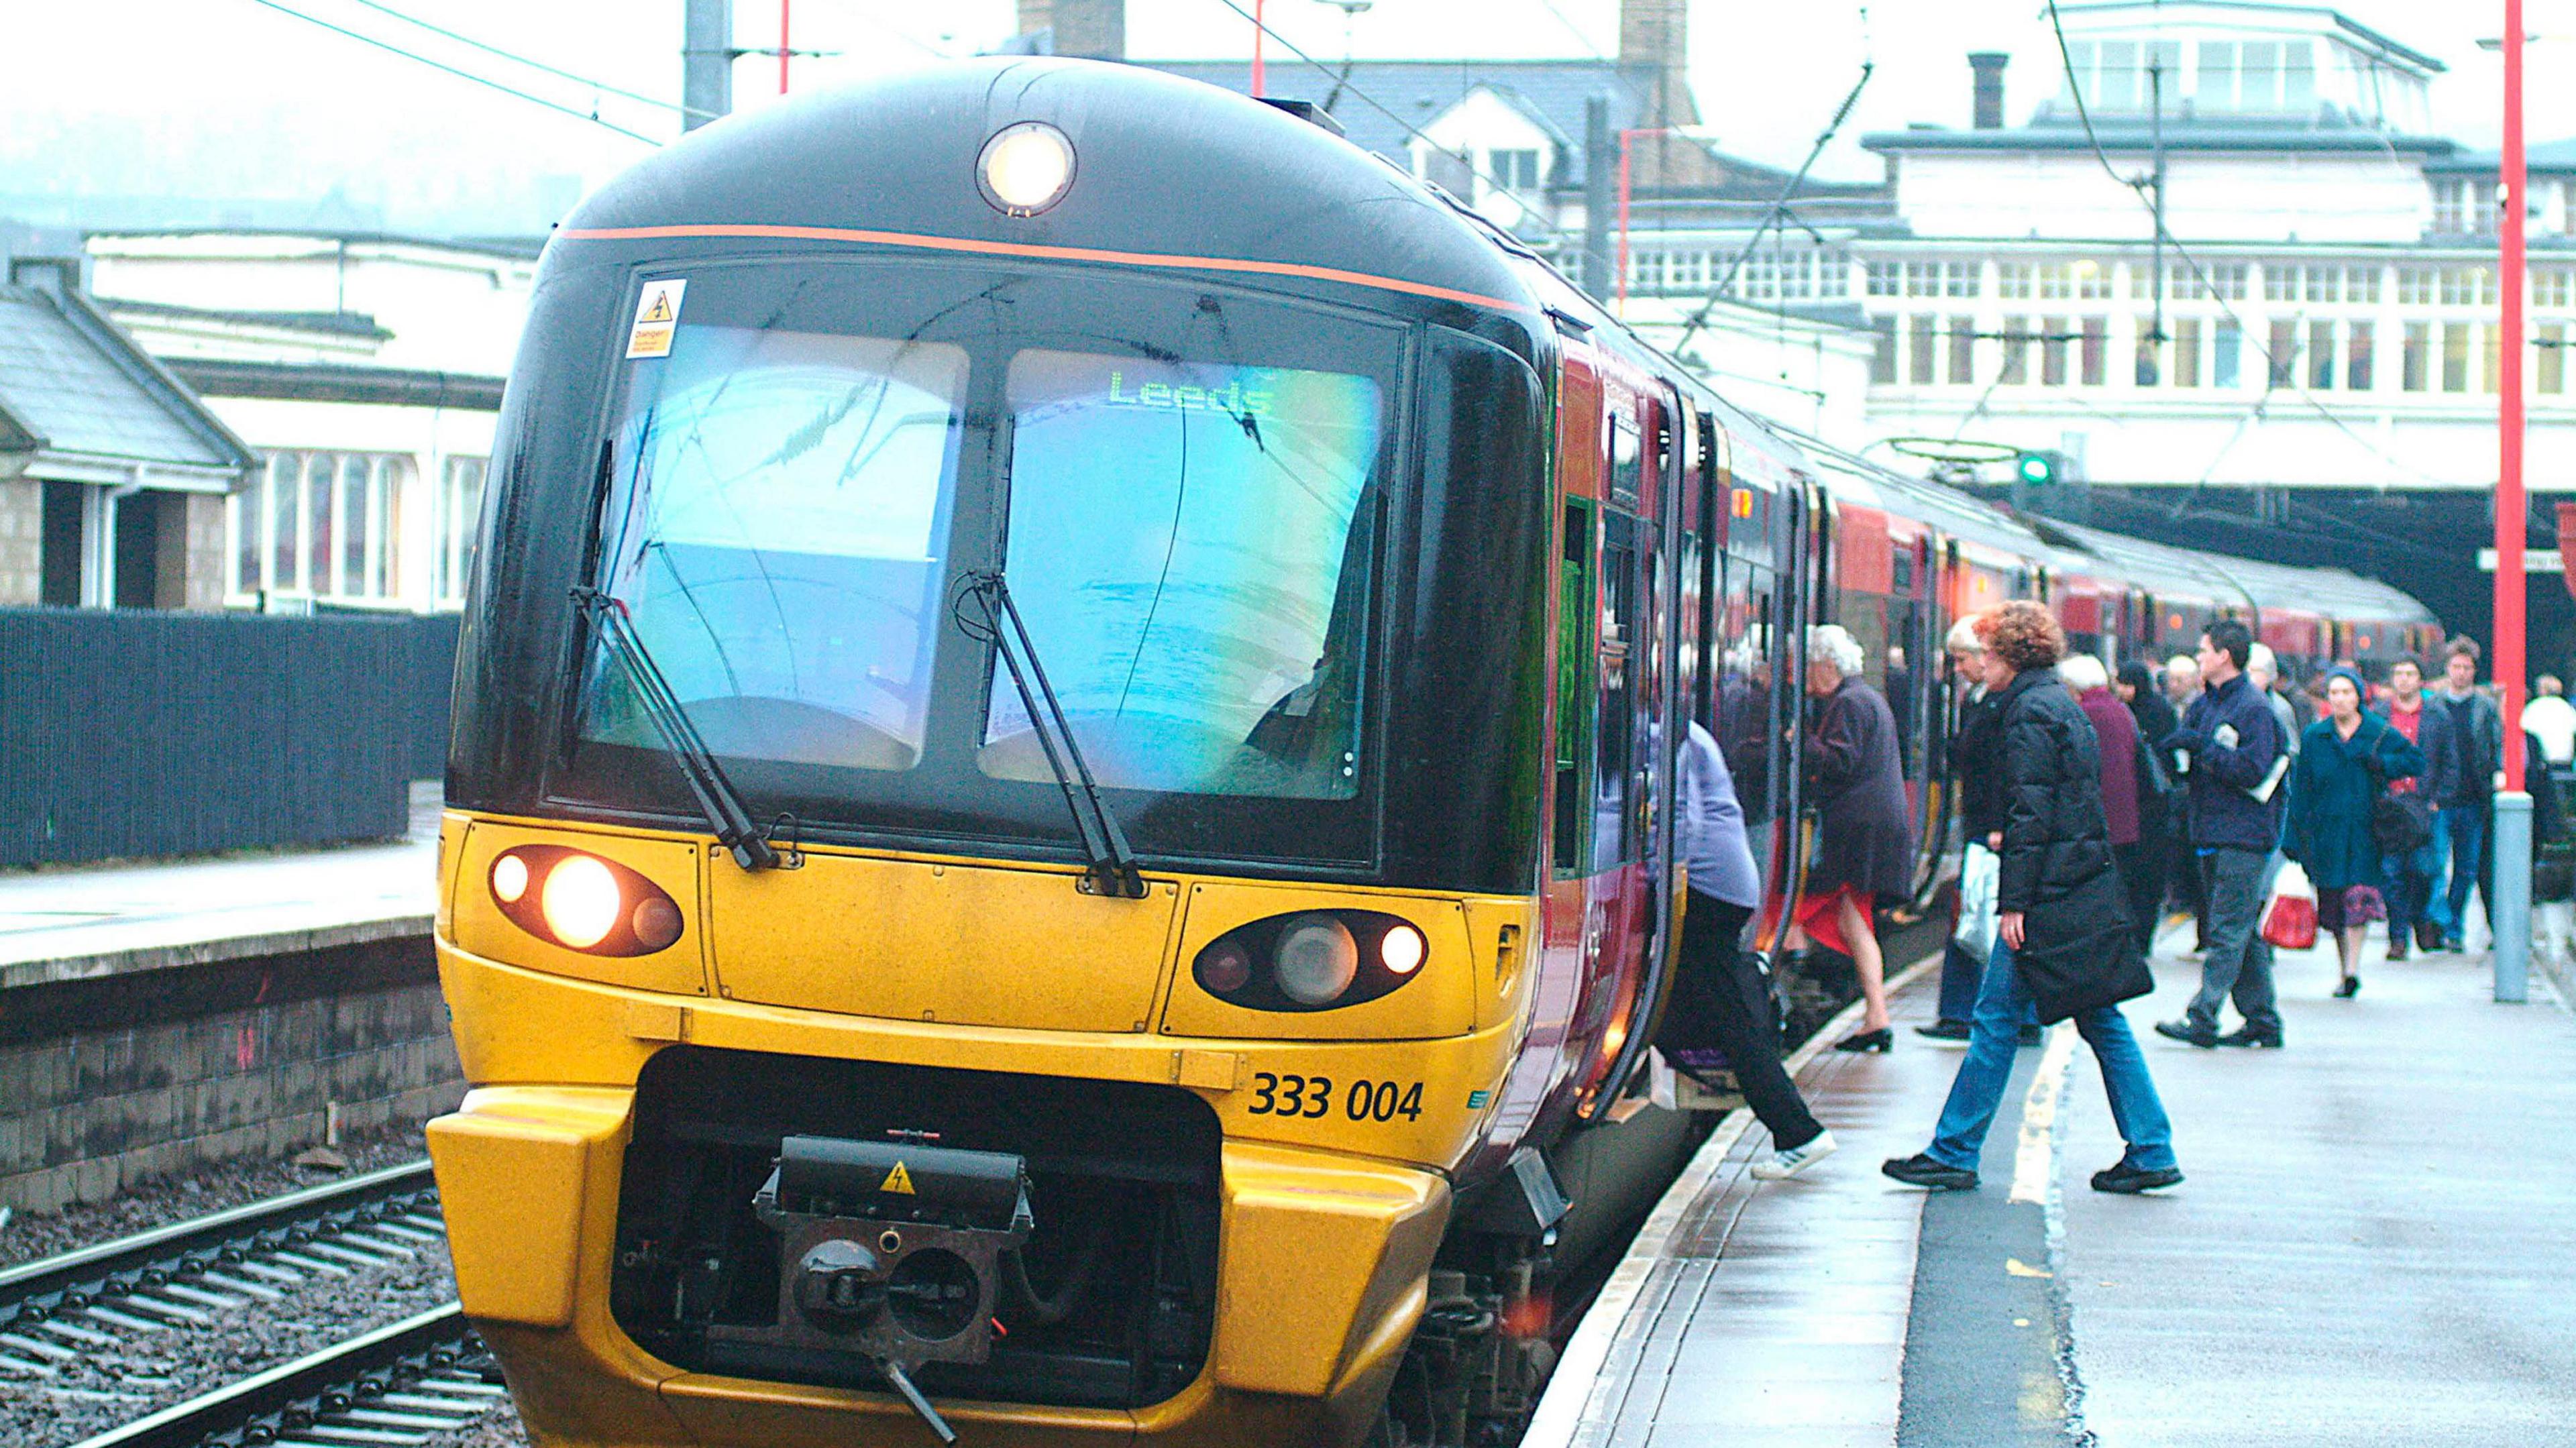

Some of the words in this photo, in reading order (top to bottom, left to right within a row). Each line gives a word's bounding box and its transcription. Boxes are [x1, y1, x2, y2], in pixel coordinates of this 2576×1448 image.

[1110, 372, 1274, 414] Leeds
[1248, 1072, 1332, 1118] 333
[1346, 1080, 1424, 1122] 004
